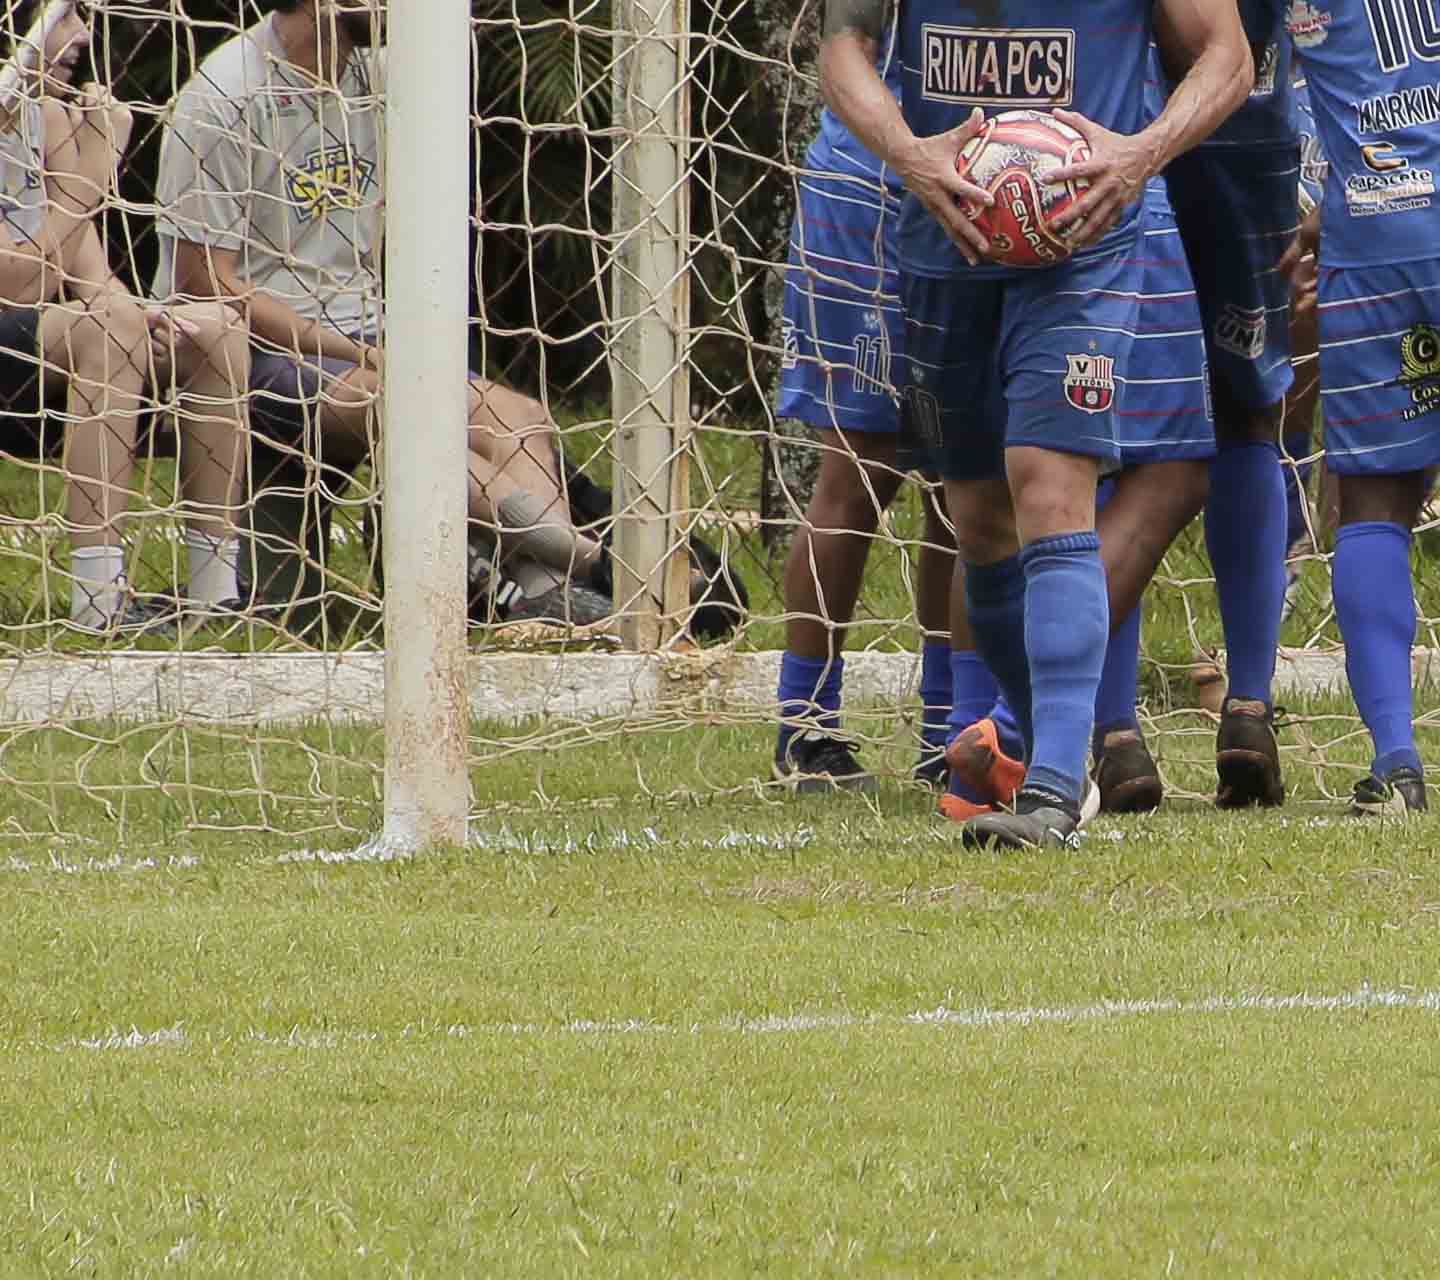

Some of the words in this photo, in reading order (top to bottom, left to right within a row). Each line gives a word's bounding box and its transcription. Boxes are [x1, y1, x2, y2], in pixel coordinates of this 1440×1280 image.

[927, 35, 1003, 96] RIMA
[1006, 40, 1064, 96] PCS
[1006, 180, 1058, 263] PENALT
